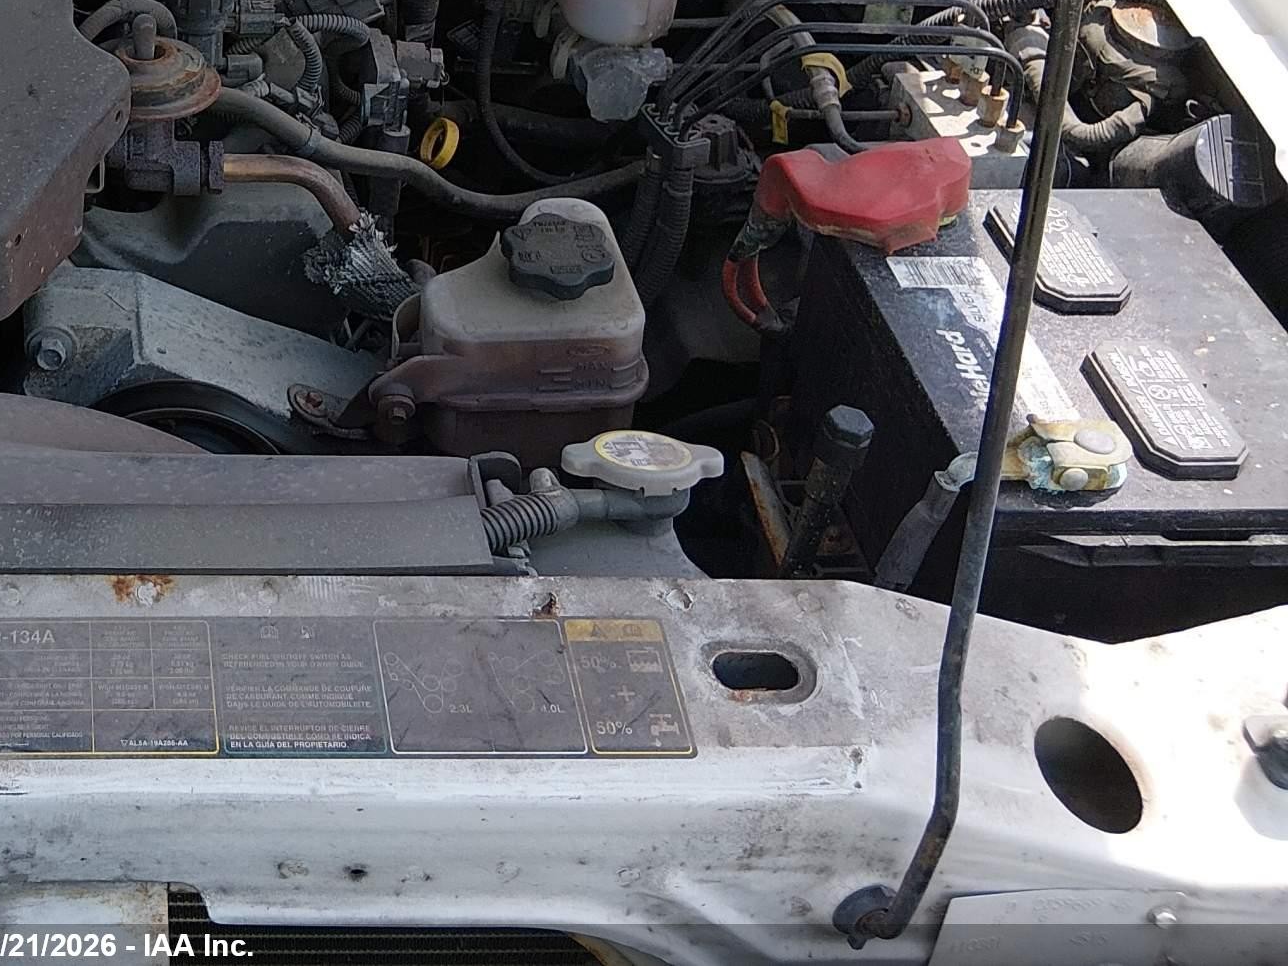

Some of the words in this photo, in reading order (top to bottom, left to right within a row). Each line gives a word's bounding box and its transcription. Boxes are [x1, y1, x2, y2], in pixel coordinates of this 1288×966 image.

[581, 654, 616, 668] 50%
[448, 704, 473, 714] 2.3L
[540, 704, 565, 714] 4.0L
[596, 721, 633, 735] 50%
[255, 740, 275, 749] GUÍA
[276, 741, 293, 749] DEL
[294, 741, 350, 749] PROPIETARIO.
